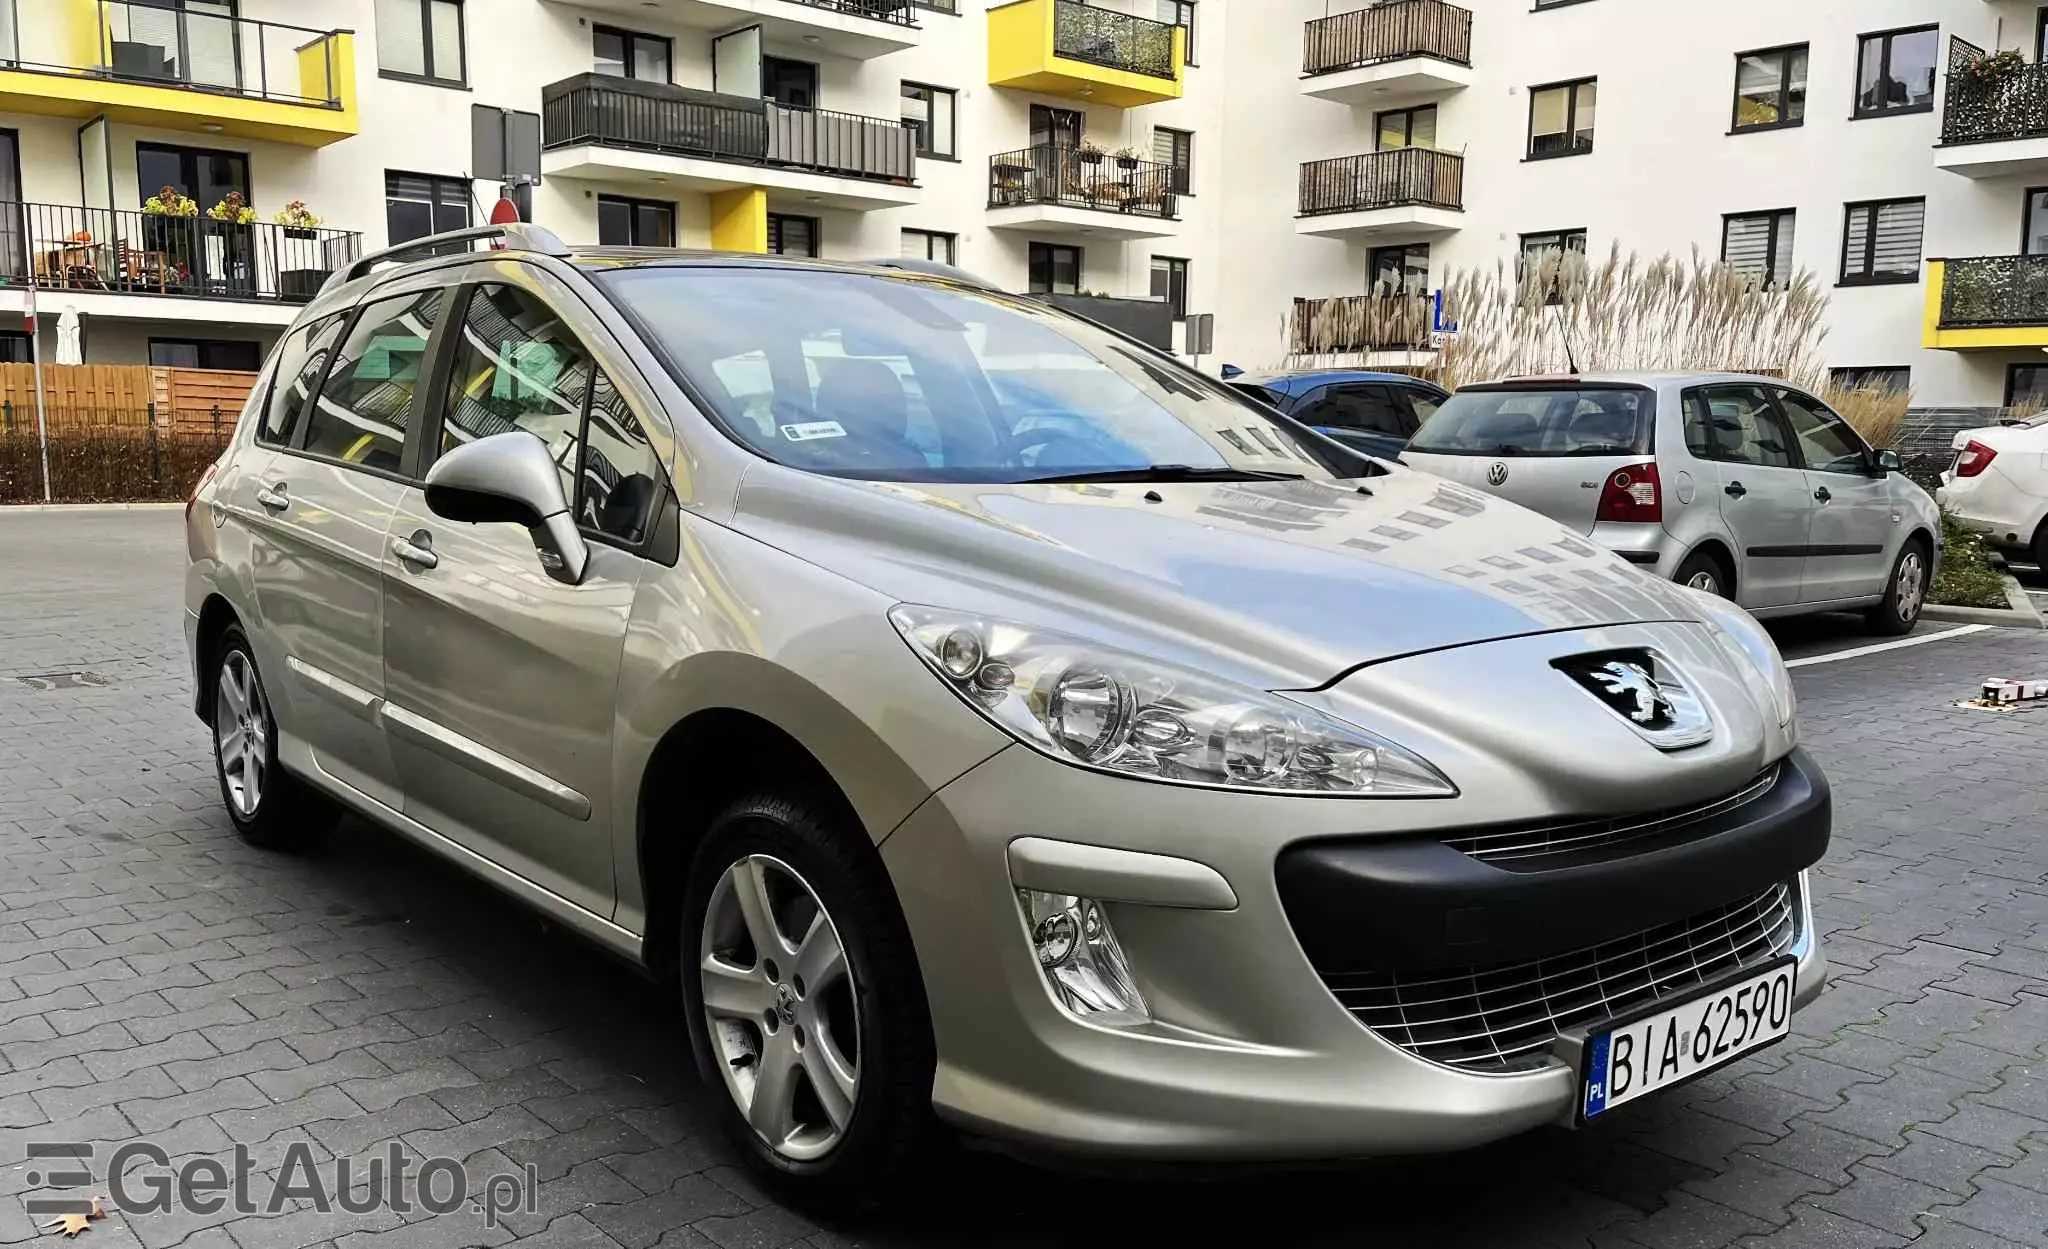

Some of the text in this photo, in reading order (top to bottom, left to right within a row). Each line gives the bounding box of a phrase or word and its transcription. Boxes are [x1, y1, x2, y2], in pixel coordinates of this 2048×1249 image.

[1610, 973, 1789, 1100] BIA 62590
[1589, 1083, 1604, 1102] PL
